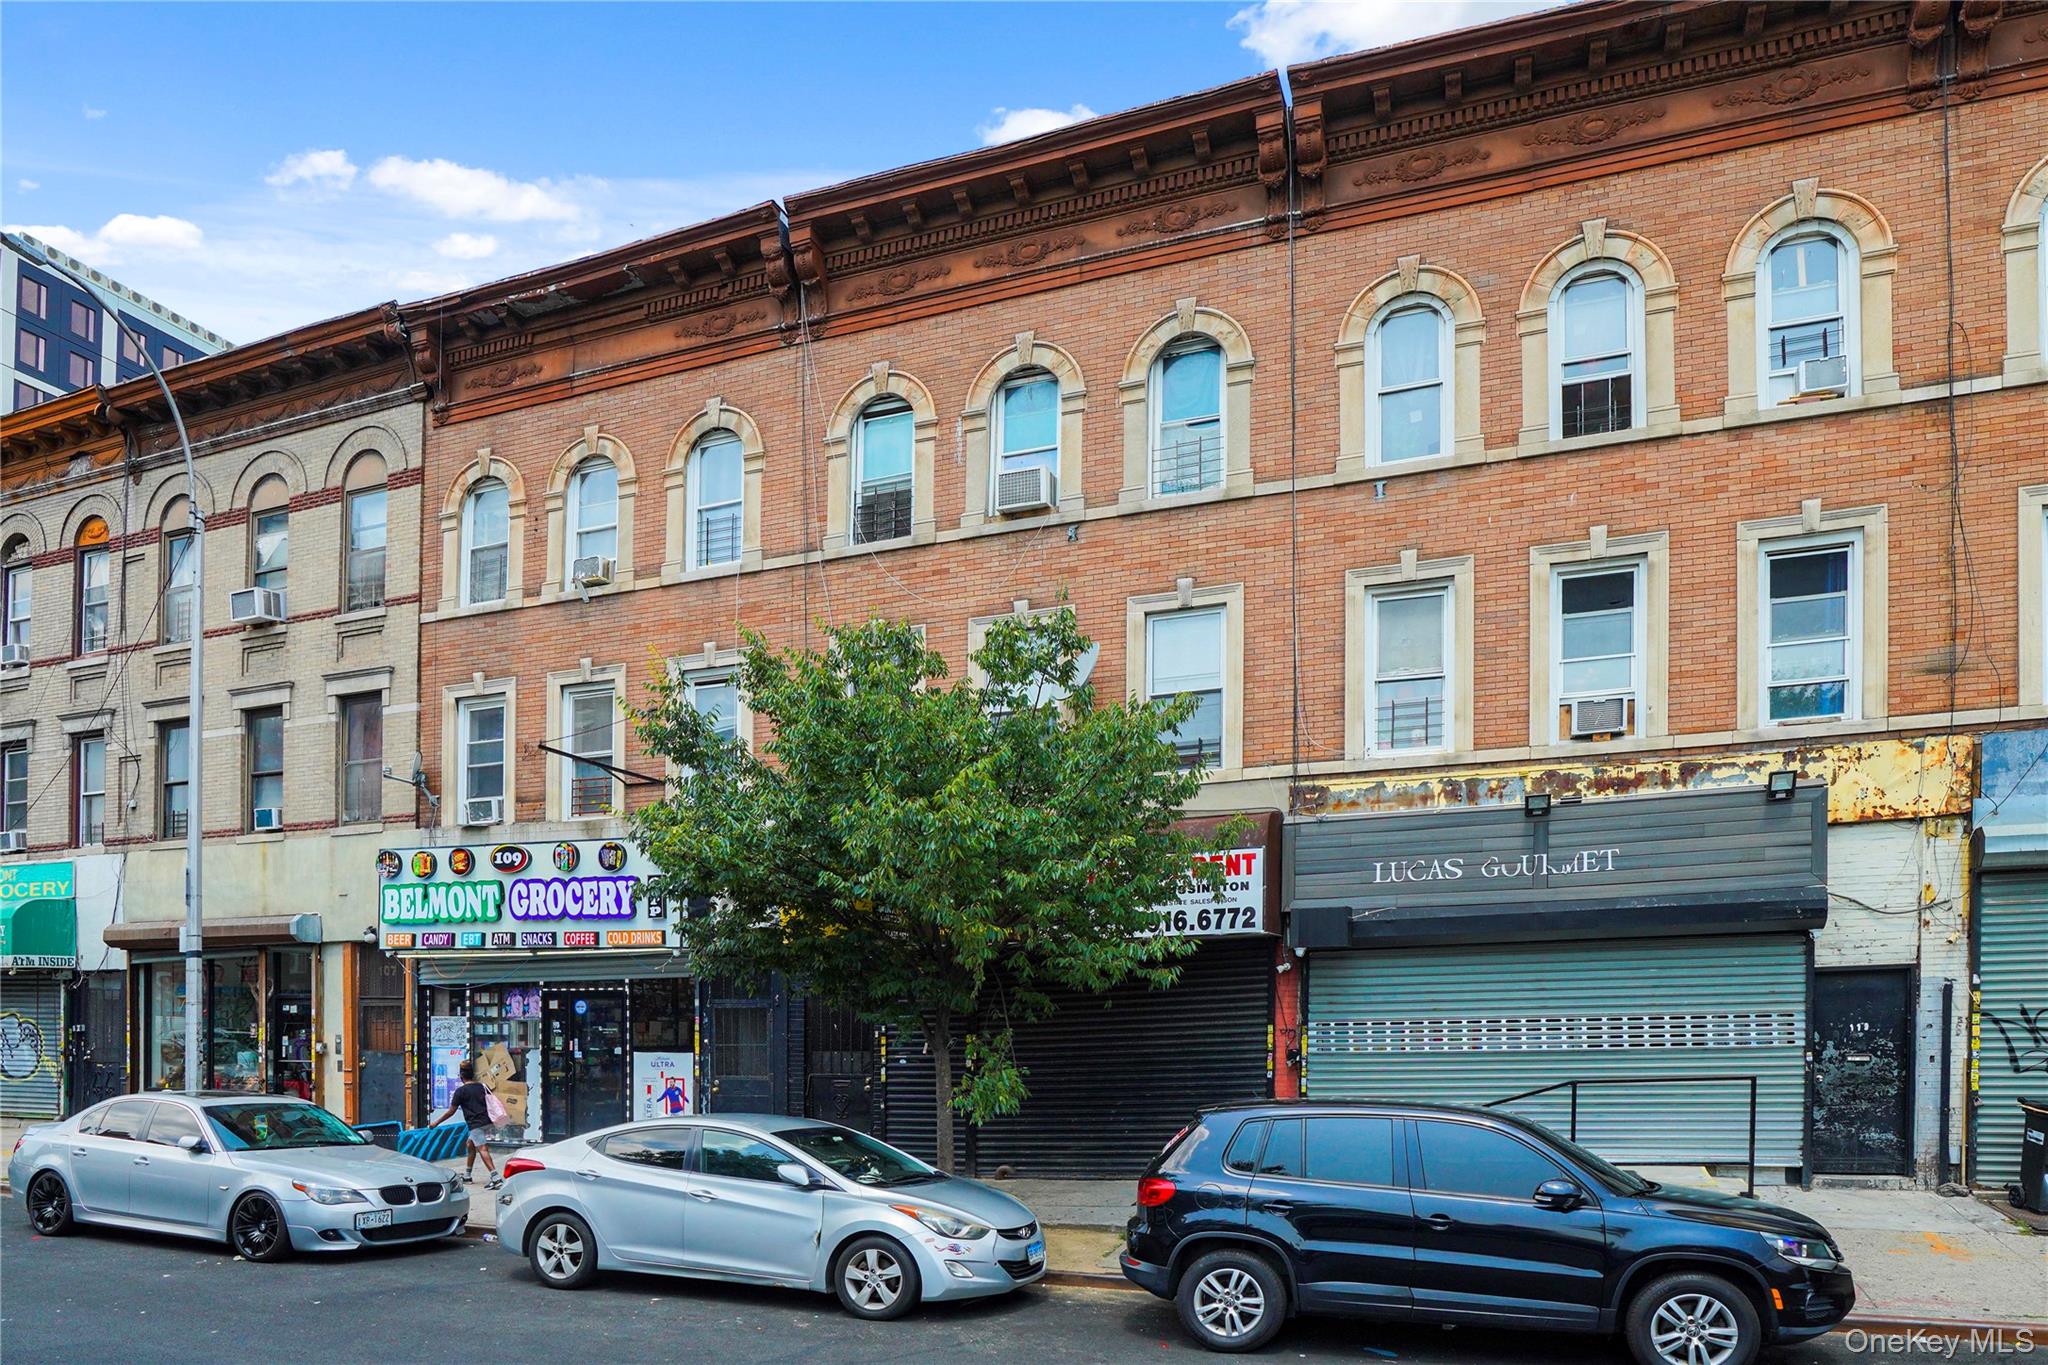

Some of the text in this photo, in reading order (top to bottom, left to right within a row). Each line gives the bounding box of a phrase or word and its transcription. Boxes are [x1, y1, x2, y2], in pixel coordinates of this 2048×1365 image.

[494, 851, 522, 865] 109
[1373, 858, 1464, 883] LUCAS
[383, 880, 637, 920] BELMONT GROCERY
[387, 933, 412, 945] BEER
[423, 932, 449, 945] CANDY
[463, 932, 481, 945] EBT
[493, 932, 511, 945] ATM
[522, 932, 553, 945] SNACKS
[565, 932, 595, 945] COFFEE
[607, 930, 663, 945] COLD DRINKS
[38, 956, 75, 967] INSIDE
